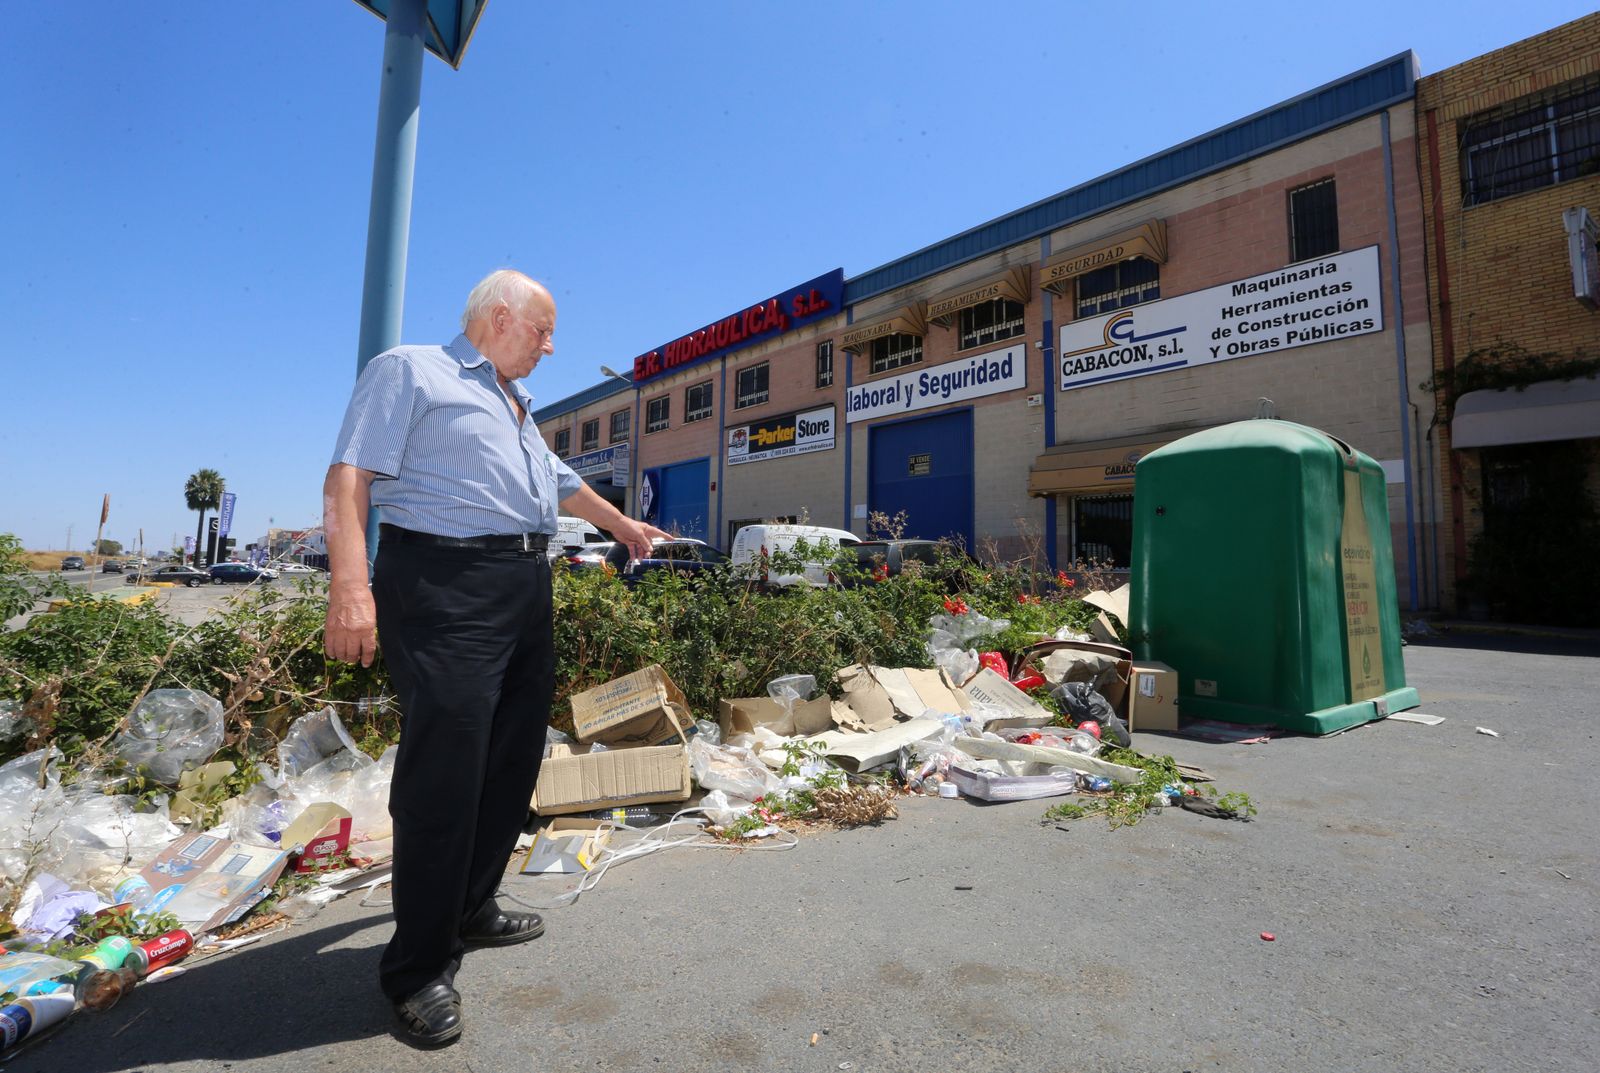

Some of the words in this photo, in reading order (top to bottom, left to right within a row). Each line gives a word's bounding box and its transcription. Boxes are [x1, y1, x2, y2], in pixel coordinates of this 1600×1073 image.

[1050, 246, 1125, 278] SEGURIDAD
[1232, 262, 1337, 297] Maquinaria
[792, 289, 829, 318] S.L.
[930, 285, 999, 317] HERRAMIENTAS
[1222, 281, 1353, 320] Herramientas
[843, 322, 892, 342] MAQUINARIA
[1211, 328, 1232, 340] de
[1238, 297, 1369, 335] Construcción
[1209, 346, 1220, 359] Y
[1227, 336, 1280, 356] Obras
[1287, 318, 1374, 345] Públicas
[1063, 344, 1153, 376] CABACON,
[1158, 338, 1184, 357] s.l.
[905, 383, 913, 408] y
[919, 352, 1013, 399] Seguridad
[758, 426, 796, 446] Parker
[798, 420, 830, 438] Store
[150, 937, 187, 957] Cruzcampo
